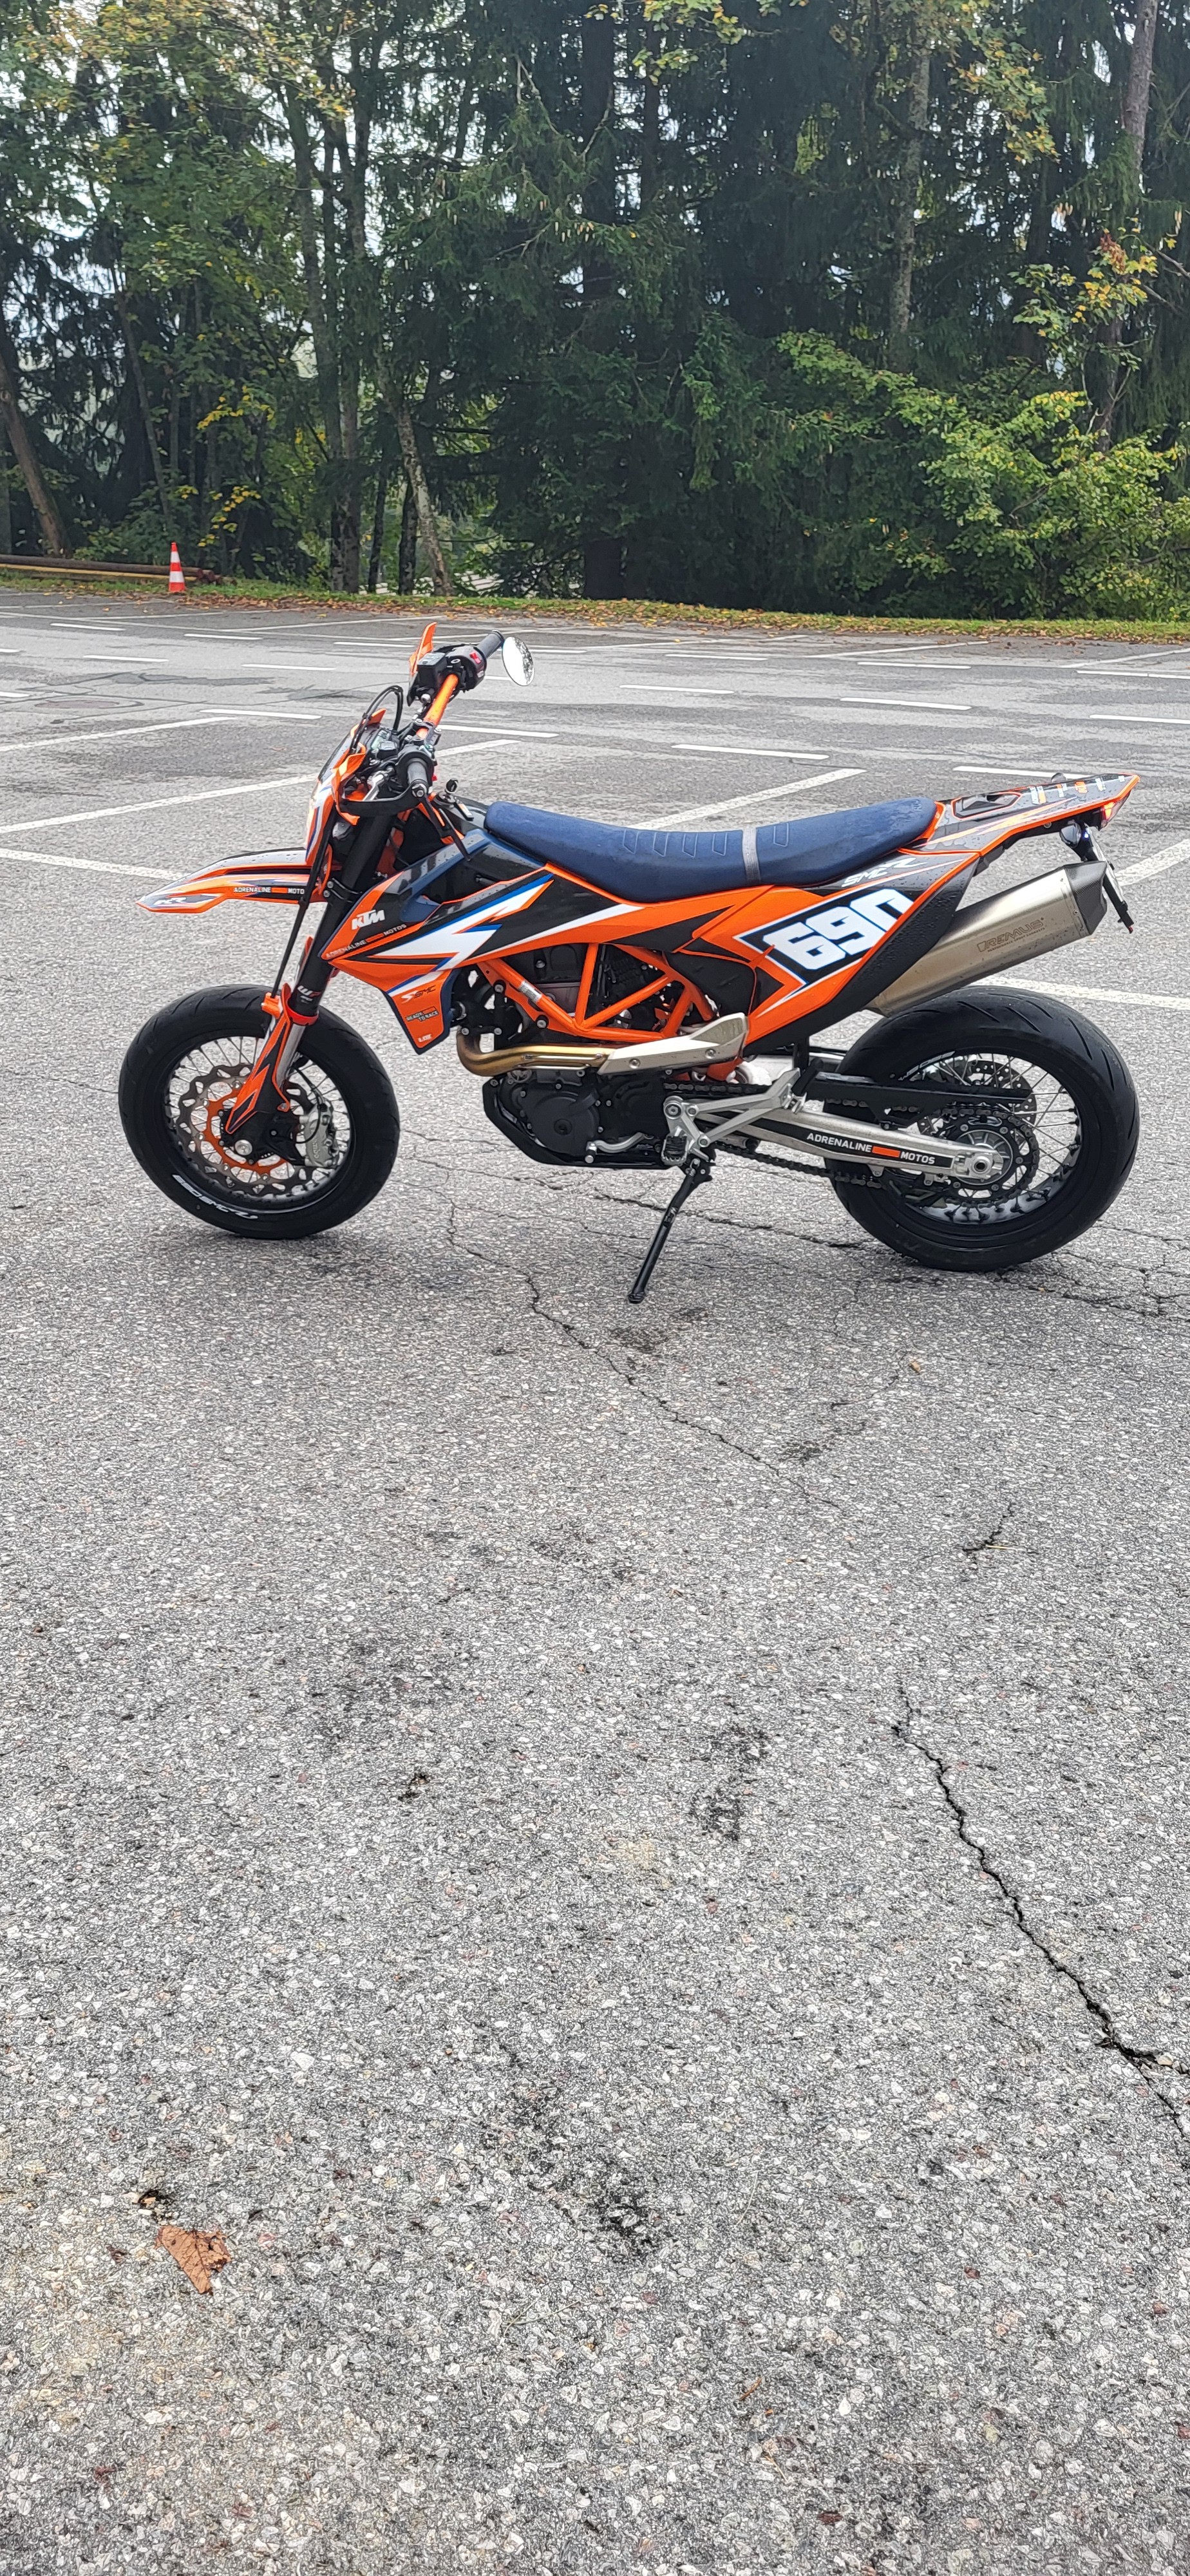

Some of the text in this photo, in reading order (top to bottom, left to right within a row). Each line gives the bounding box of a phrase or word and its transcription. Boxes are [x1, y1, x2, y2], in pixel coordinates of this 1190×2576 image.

[352, 909, 386, 930] KTM
[762, 888, 914, 971] 690
[985, 919, 1044, 949] REMUS
[325, 923, 407, 958] ADRENALINE MOTOS
[806, 1133, 936, 1164] ADRENALINE MOTOS
